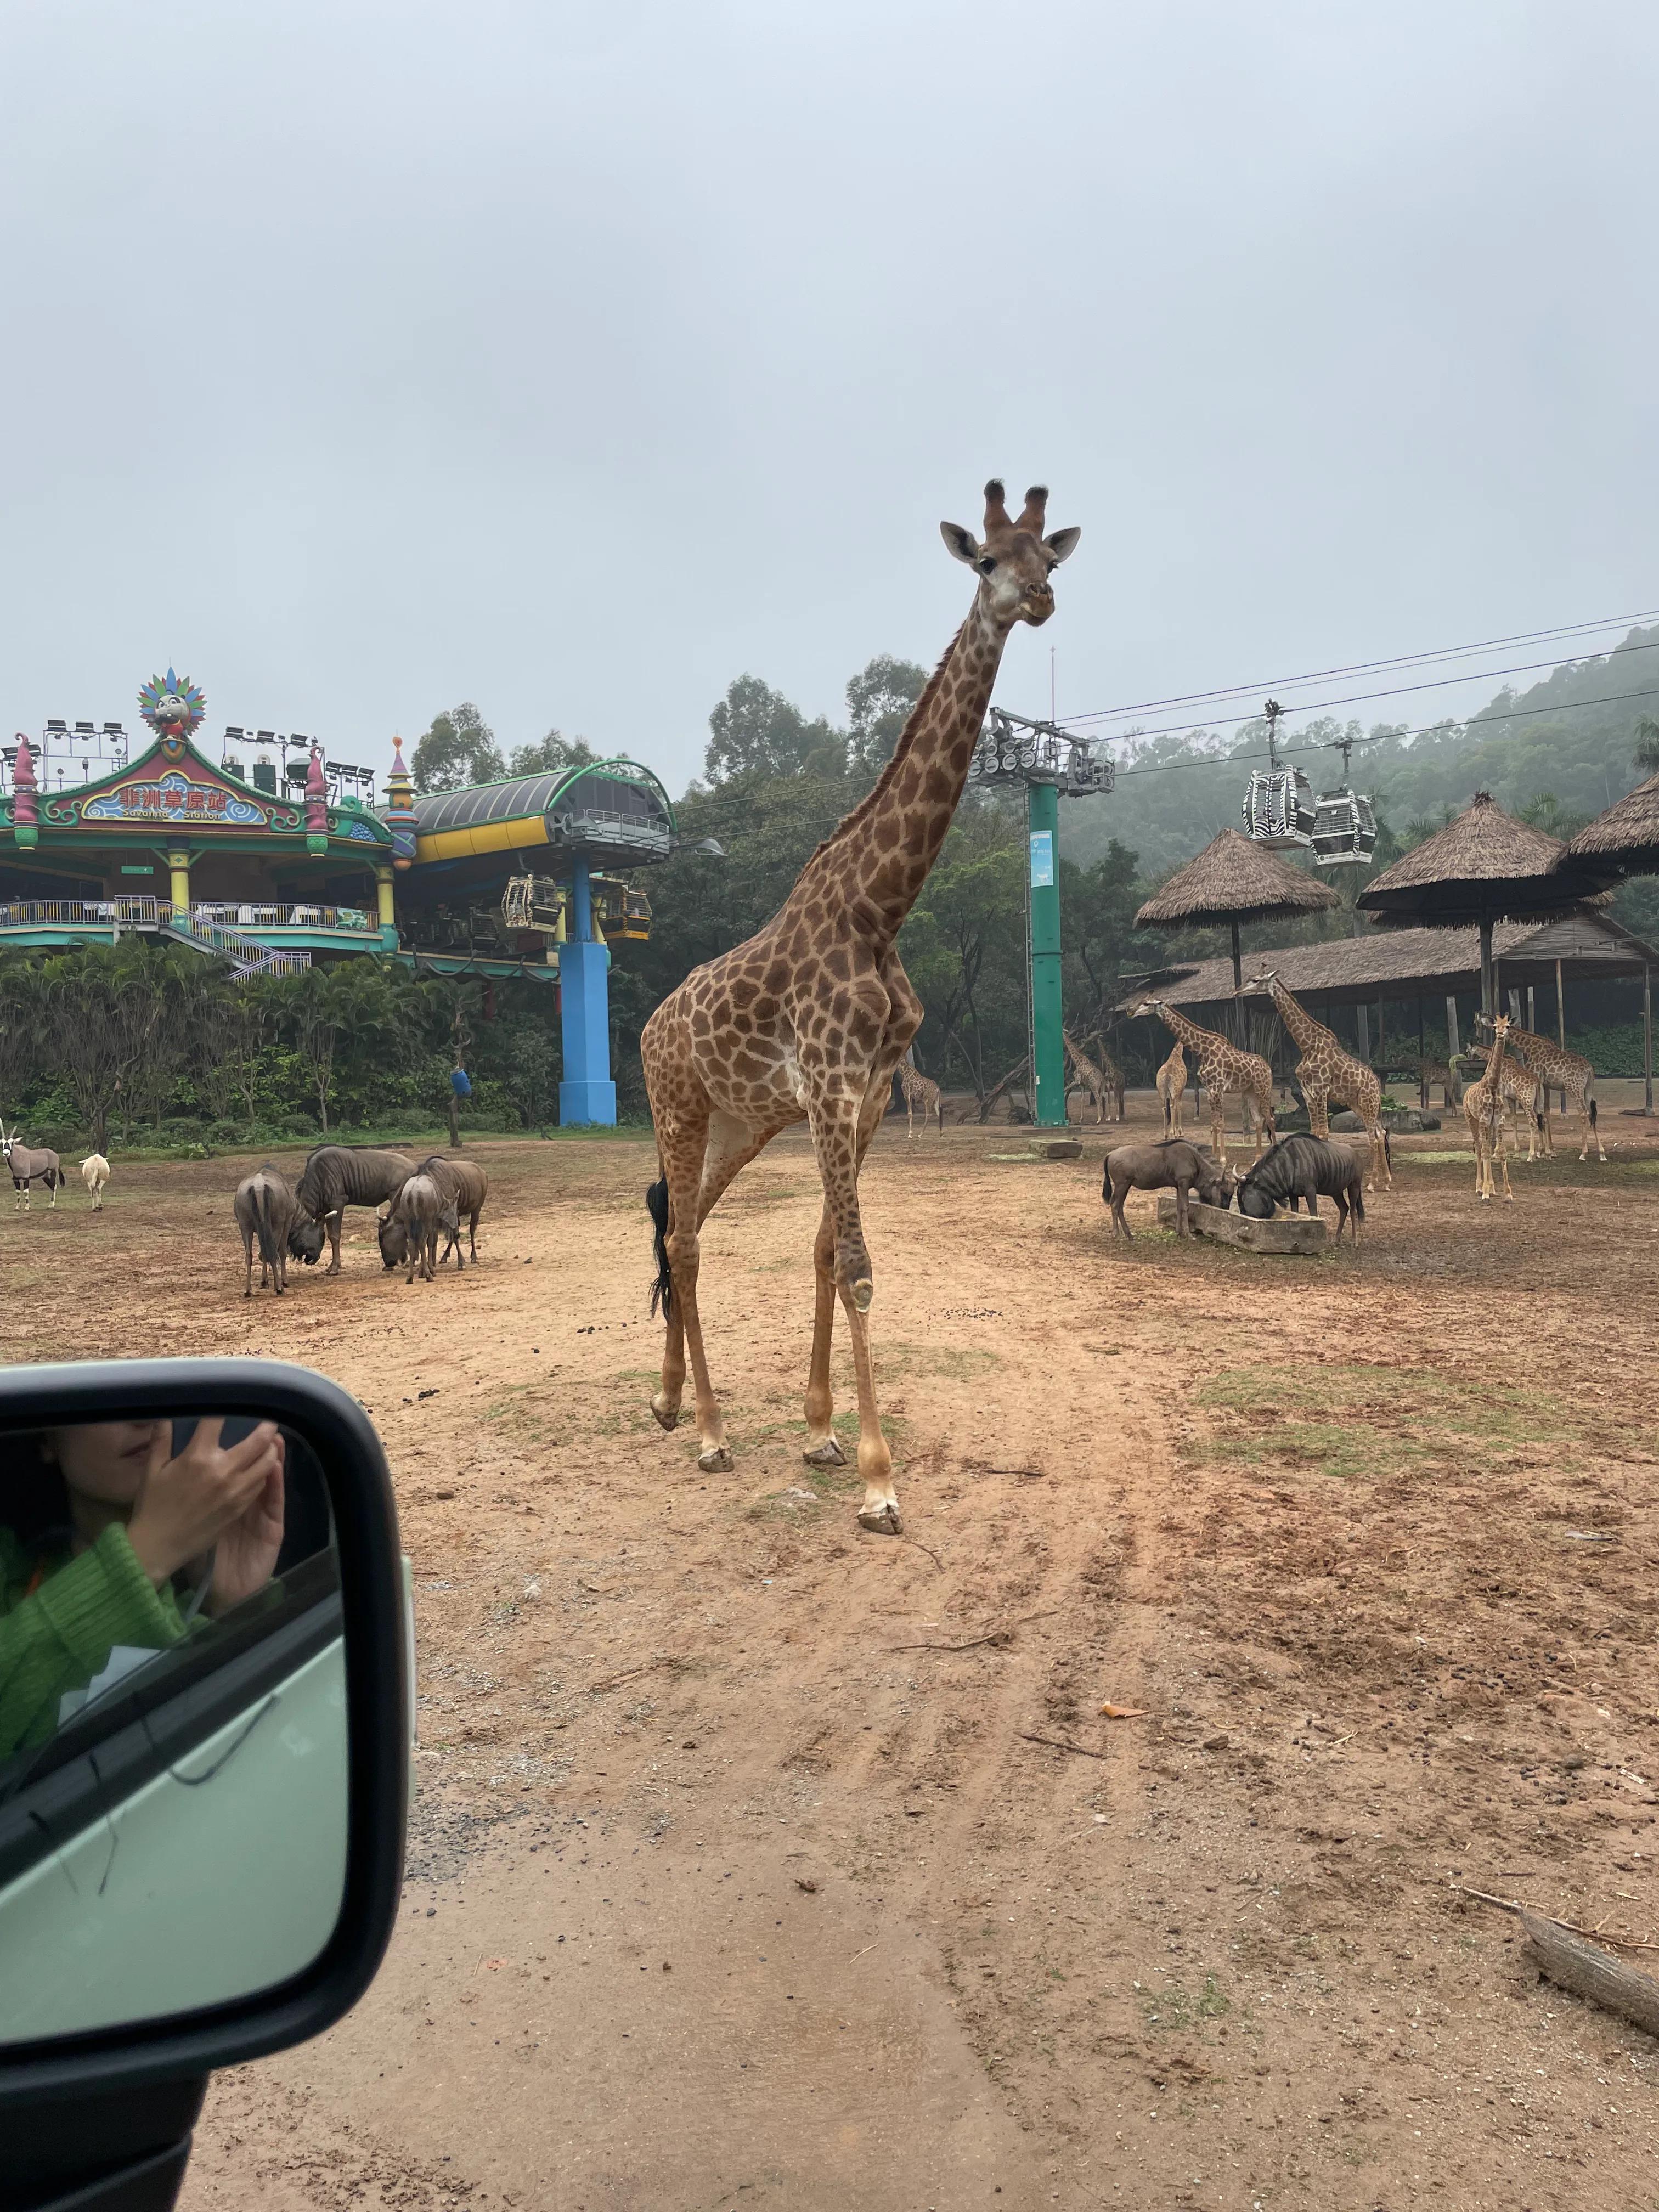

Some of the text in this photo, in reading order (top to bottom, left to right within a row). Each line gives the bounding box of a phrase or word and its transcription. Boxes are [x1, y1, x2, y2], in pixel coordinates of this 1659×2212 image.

[120, 787, 228, 810] 非洲草原站
[123, 809, 168, 817] Savanna
